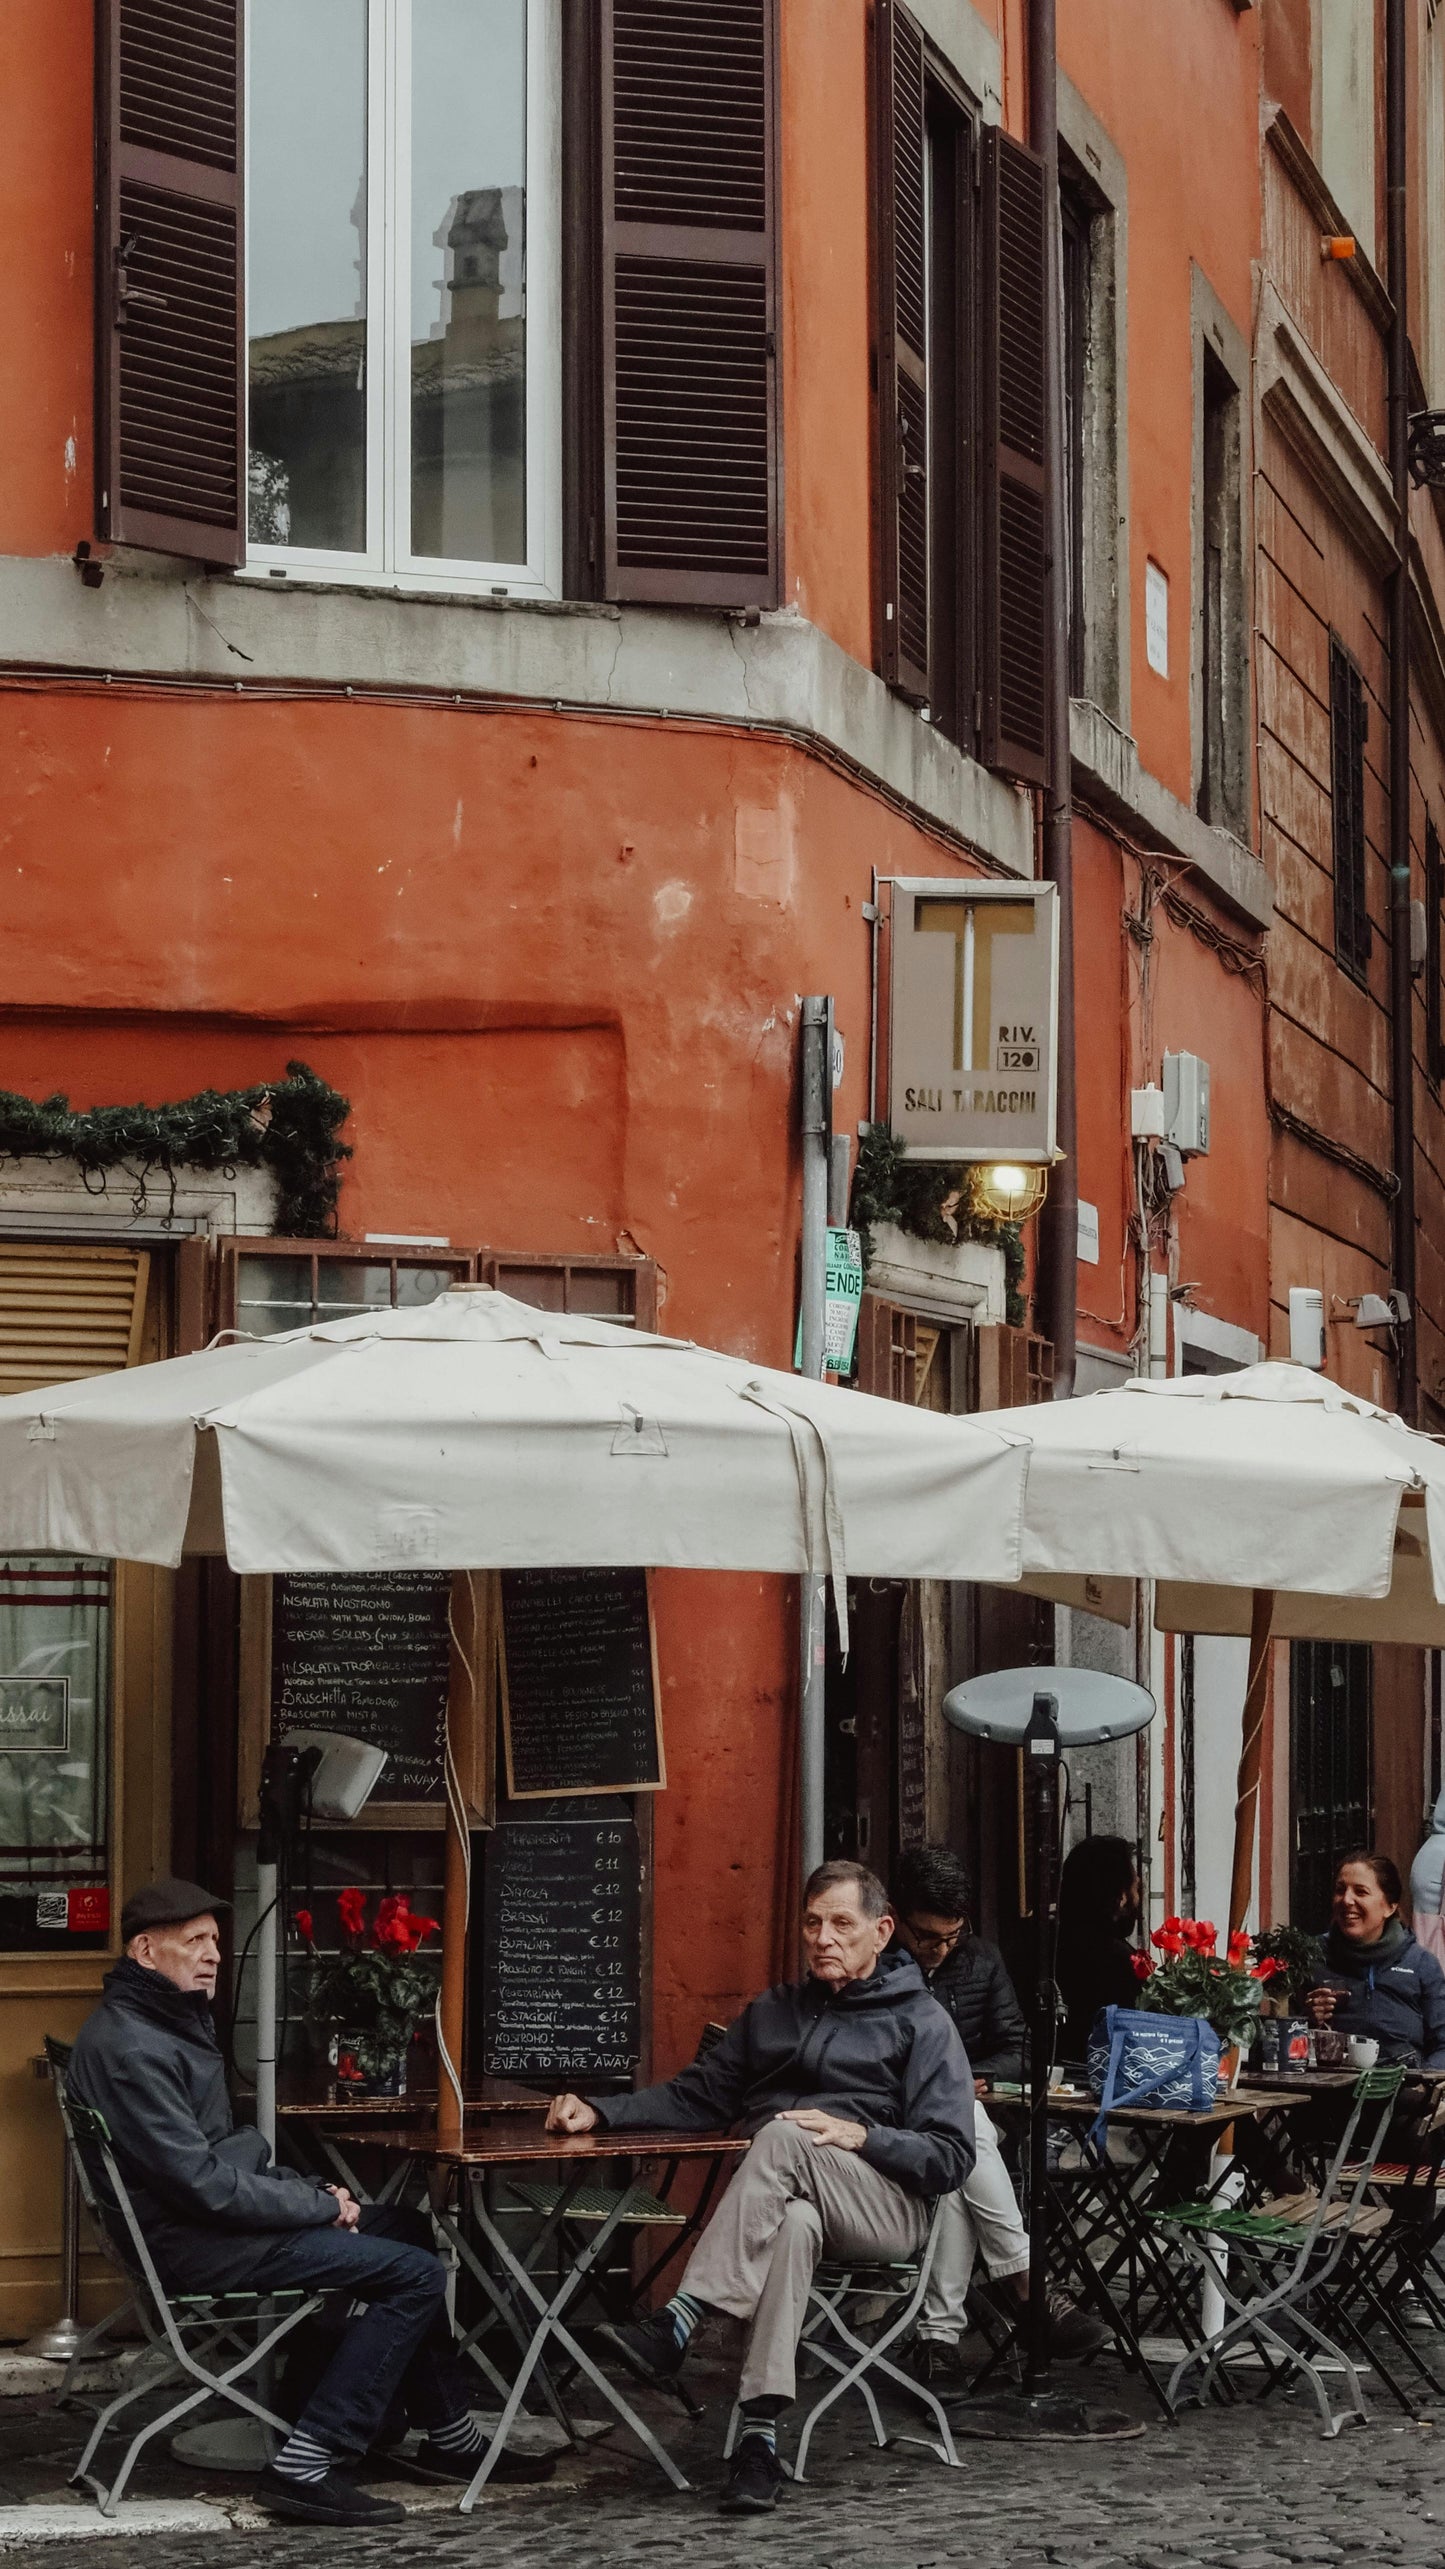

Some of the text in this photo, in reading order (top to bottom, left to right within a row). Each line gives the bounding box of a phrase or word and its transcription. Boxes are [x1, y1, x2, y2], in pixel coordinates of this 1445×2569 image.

[998, 1026, 1036, 1042] RIV.
[1003, 1052, 1034, 1067] 120
[905, 1088, 942, 1112] SALI
[826, 1271, 861, 1295] ENDE
[283, 1594, 329, 1608] INSALATA
[330, 1614, 352, 1622] WITH
[354, 1614, 374, 1622] TUNA
[282, 1661, 340, 1675] INSALATA
[346, 1710, 378, 1720] MISTA
[403, 1774, 439, 1794] AWAY
[489, 2055, 630, 2070] EVEN TO TAKE AWAY
